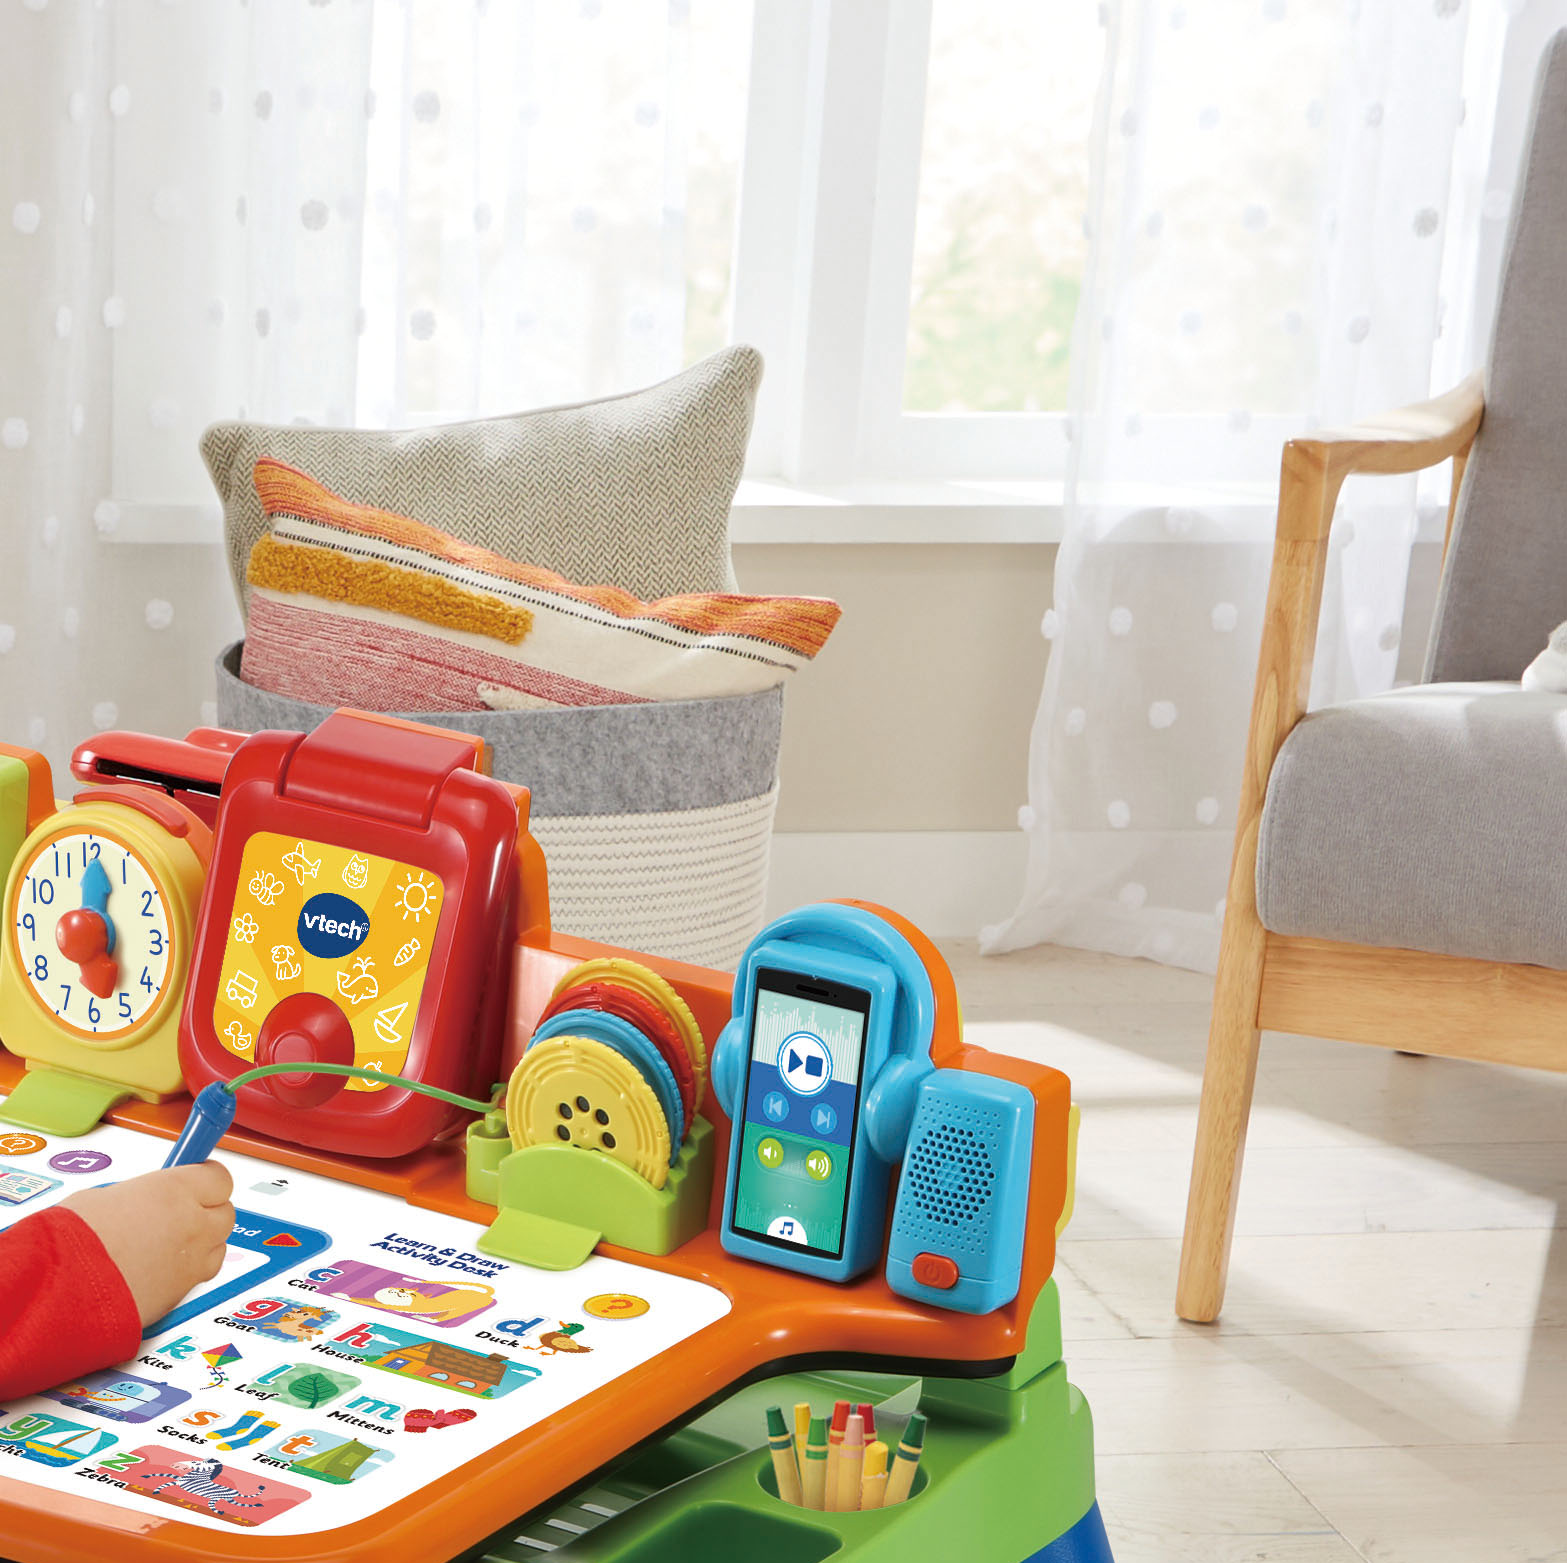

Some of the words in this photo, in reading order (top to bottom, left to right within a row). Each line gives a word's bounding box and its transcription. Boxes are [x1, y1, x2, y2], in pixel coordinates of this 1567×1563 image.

[55, 851, 71, 878] 11
[82, 842, 101, 868] 12
[121, 859, 127, 884] 1
[32, 878, 54, 905] 10
[141, 890, 154, 917] 2
[23, 913, 35, 941] 9
[149, 929, 163, 955] 3
[34, 955, 48, 981] 8
[139, 966, 153, 993] 4
[60, 985, 71, 1010] 7
[119, 992, 132, 1018] 5
[88, 997, 101, 1023] 6
[233, 1223, 262, 1237] ad
[370, 1241, 448, 1266] Activity
[447, 1261, 498, 1278] Desk
[384, 1233, 437, 1252] Learn
[438, 1248, 457, 1256] &
[456, 1252, 510, 1271] Draw
[287, 1279, 318, 1292] Cat
[308, 1268, 344, 1282] c
[232, 1299, 284, 1320] g
[213, 1316, 257, 1333] Goat
[333, 1323, 373, 1348] h
[495, 1317, 545, 1337] d
[155, 1335, 196, 1360] k
[475, 1330, 520, 1348] Duck
[137, 1355, 173, 1371] Kite
[311, 1344, 365, 1364] House
[257, 1364, 293, 1384] l
[234, 1384, 280, 1401] Leaf
[182, 1411, 221, 1426] s
[345, 1396, 401, 1420] m
[326, 1410, 395, 1435] Mittens
[157, 1425, 209, 1446] Socks
[281, 1435, 315, 1455] t
[98, 1453, 143, 1471] z
[252, 1453, 291, 1470] Tent
[75, 1467, 128, 1489] Zebra
